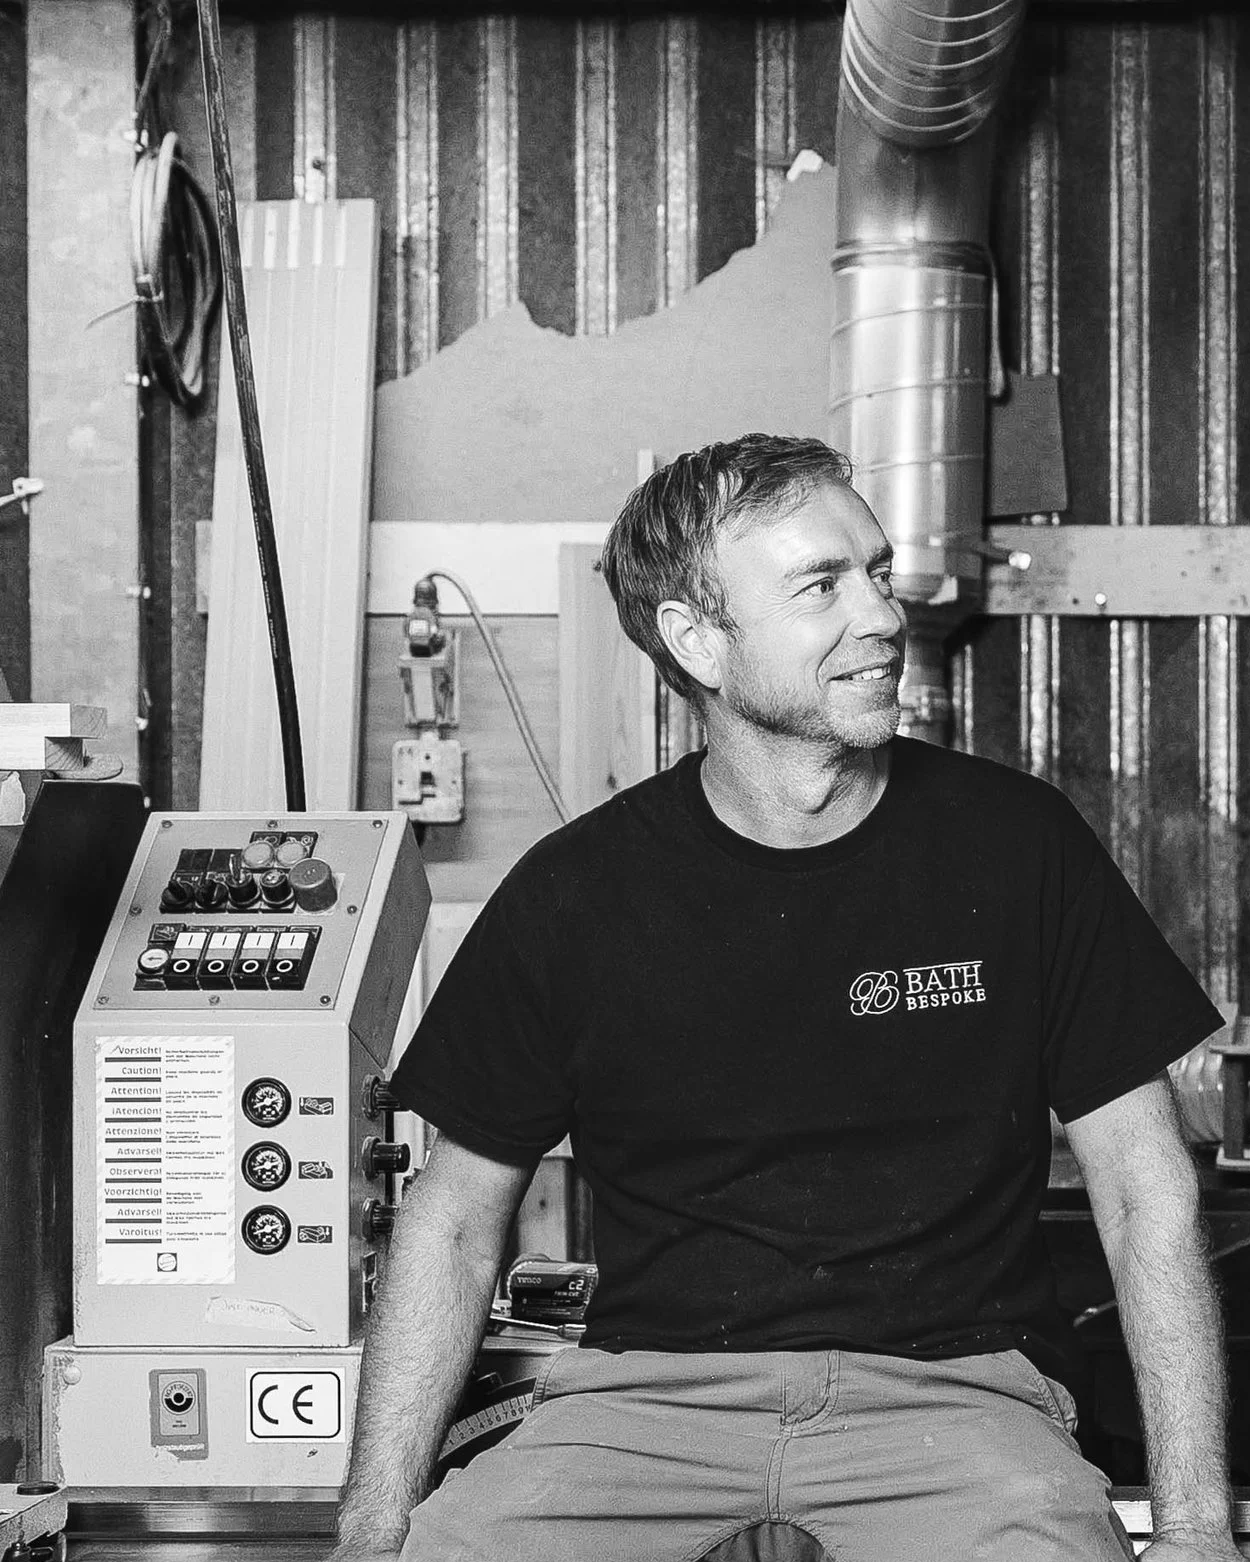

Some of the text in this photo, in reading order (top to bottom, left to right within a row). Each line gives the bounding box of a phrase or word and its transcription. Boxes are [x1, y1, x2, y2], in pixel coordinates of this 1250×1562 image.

[904, 963, 983, 995] BATH
[905, 988, 987, 1011] BESPOKE
[118, 1046, 162, 1055] Vorsicht!
[121, 1066, 162, 1075] Caution!
[110, 1087, 162, 1095] Attention!
[117, 1208, 162, 1216] Advarsel!
[119, 1228, 162, 1236] Varoitus!
[257, 1384, 314, 1425] CE
